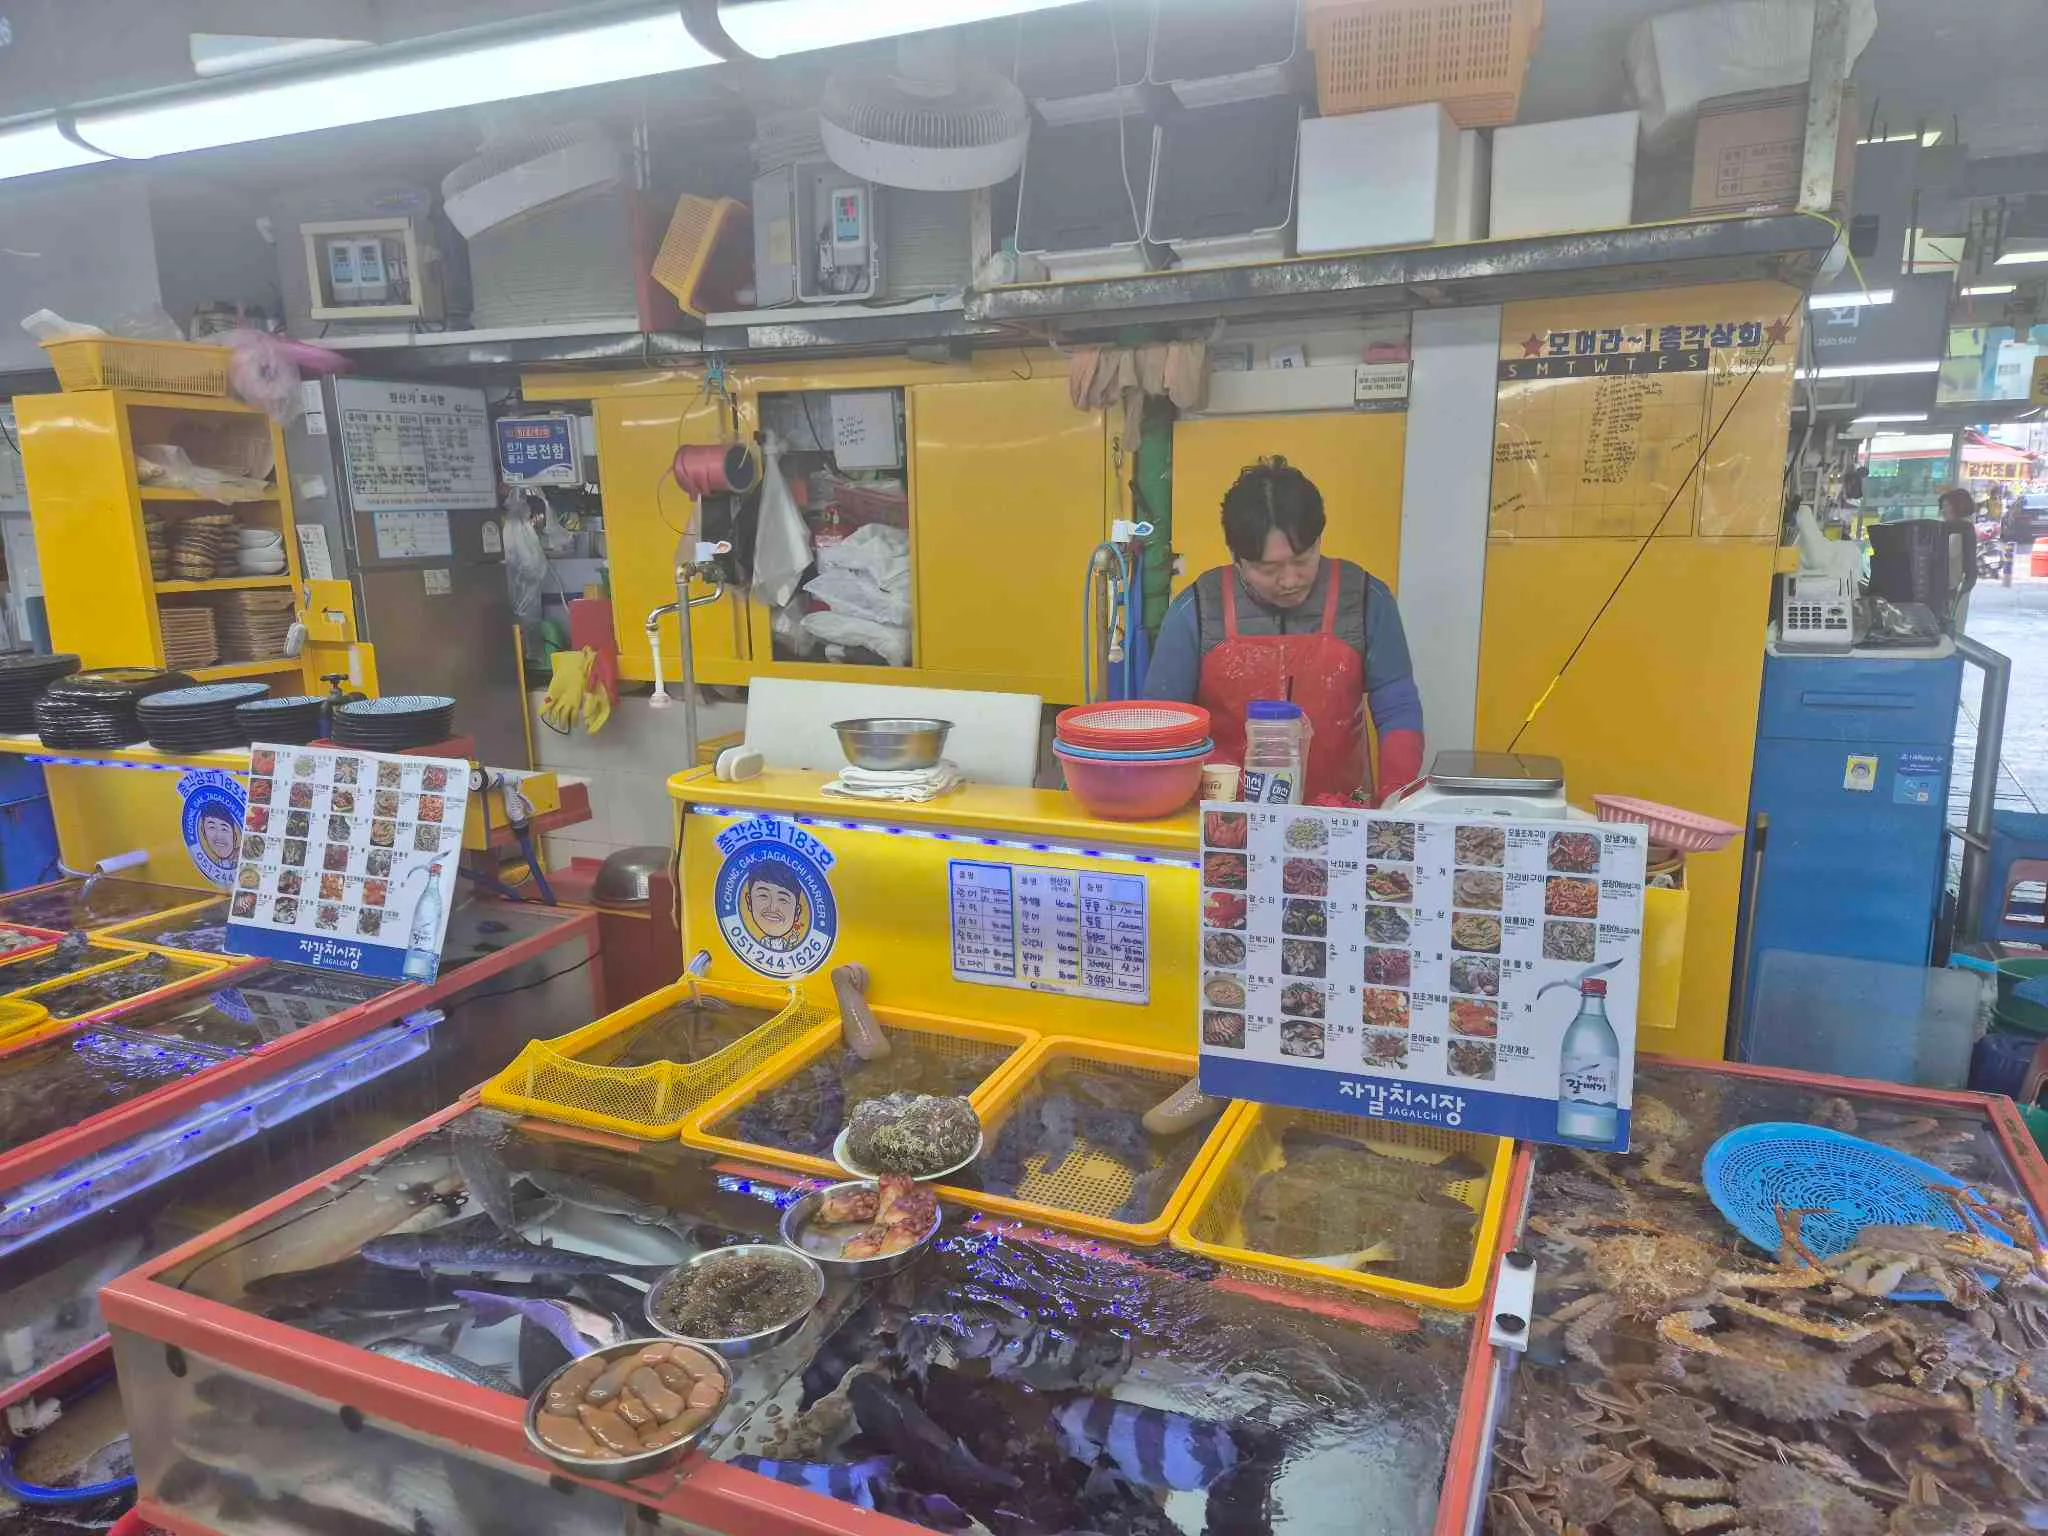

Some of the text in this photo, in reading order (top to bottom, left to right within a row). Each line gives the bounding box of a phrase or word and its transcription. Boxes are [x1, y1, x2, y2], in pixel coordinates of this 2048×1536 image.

[1658, 320, 1763, 352] 총각상회
[1508, 354, 1698, 377] S M T W T F S
[526, 443, 565, 460] 분전함
[716, 819, 835, 872] 총각상회 183호
[298, 939, 363, 970] 자갈치시장
[1566, 1079, 1607, 1094] 갈매기
[1339, 1080, 1467, 1127] 자갈치시장
[1387, 1105, 1444, 1124] JAGALCHI
